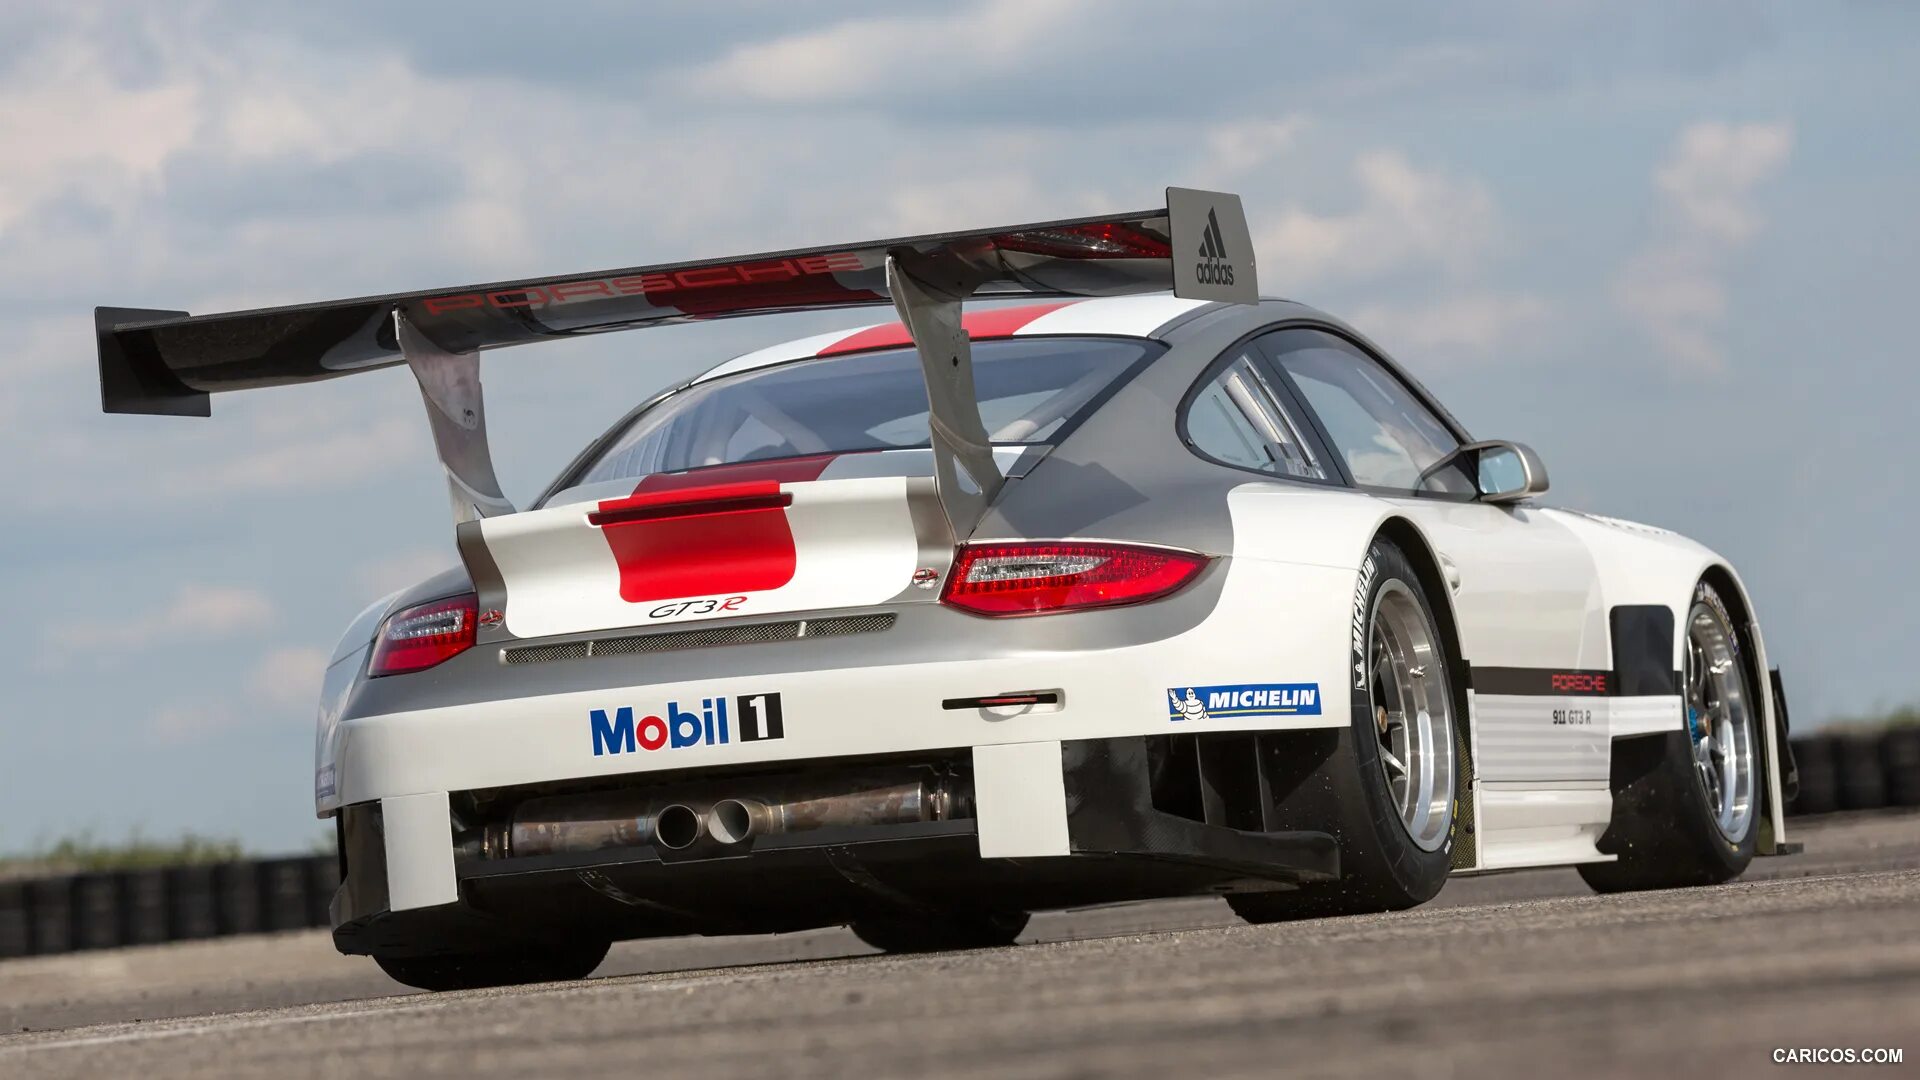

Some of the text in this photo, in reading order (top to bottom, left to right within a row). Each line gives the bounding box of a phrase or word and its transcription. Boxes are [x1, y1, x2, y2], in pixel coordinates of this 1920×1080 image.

[424, 252, 864, 316] PORSCHE
[1196, 256, 1234, 286] adidas
[1353, 556, 1375, 657] MICHELIN
[1552, 674, 1606, 691] PORSCHE
[1208, 689, 1315, 709] MICHELIN
[589, 697, 729, 757] Mobil
[1552, 710, 1592, 725] 911 GT3 R
